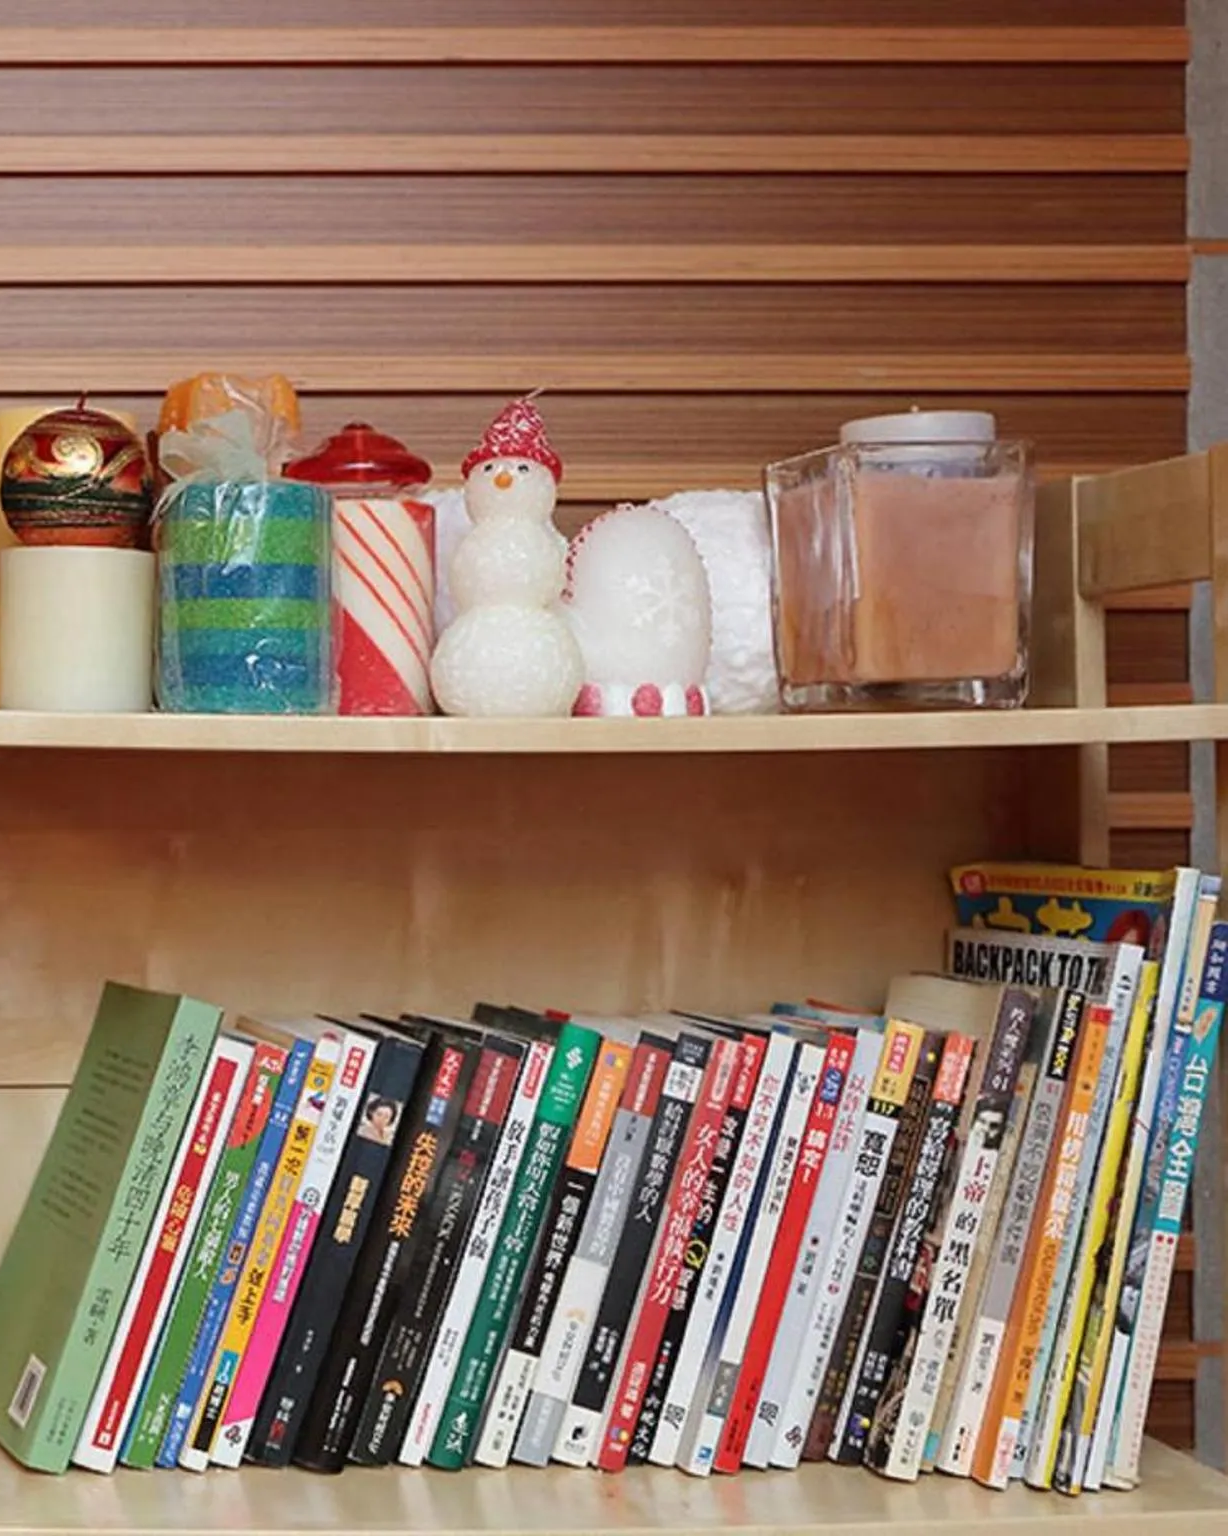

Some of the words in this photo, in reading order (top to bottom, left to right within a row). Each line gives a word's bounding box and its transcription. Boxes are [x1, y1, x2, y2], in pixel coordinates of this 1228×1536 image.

[953, 940, 1052, 987] BACKPACK
[1058, 953, 1084, 989] TO
[389, 1131, 439, 1237] 失控的未來
[635, 1103, 684, 1224] 給討厭數學的人
[723, 1075, 779, 1232] 你不可不知的人性
[855, 1130, 887, 1178] 寬恕
[545, 1181, 586, 1268] 一個新世界
[650, 1124, 720, 1305] 女人的幸福執行力
[932, 1156, 993, 1323] 上帝的黑名單
